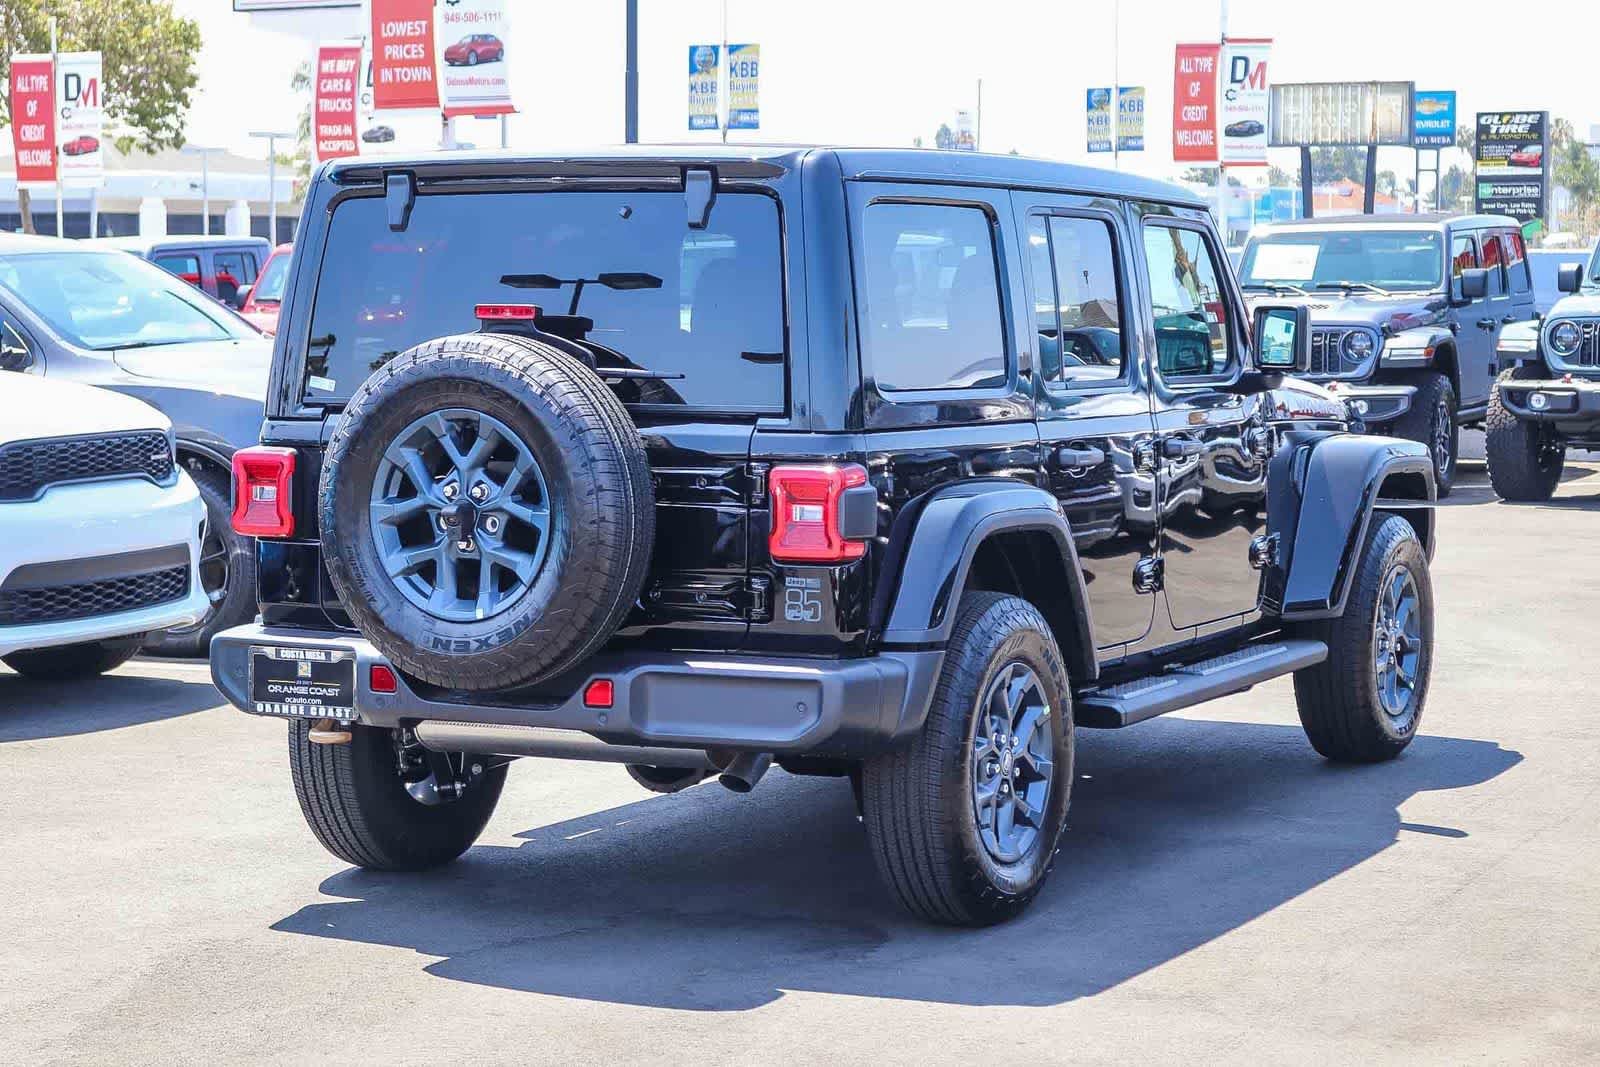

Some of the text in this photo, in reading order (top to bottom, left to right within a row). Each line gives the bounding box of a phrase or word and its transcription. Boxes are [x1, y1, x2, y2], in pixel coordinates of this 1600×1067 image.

[381, 21, 428, 38] LOWEST
[384, 44, 424, 60] PRICES
[321, 59, 356, 73] WE BUY
[730, 61, 758, 78] KBB
[1180, 57, 1214, 73] ALL TYPE
[380, 67, 432, 83] IN TOWN
[15, 75, 49, 92] ALL TYPE
[320, 78, 343, 93] CARS
[1190, 81, 1201, 97] OF
[26, 99, 38, 118] OF
[319, 98, 352, 112] TRUCKS
[1182, 105, 1208, 121] CREDIT
[1480, 113, 1541, 125] GLOBE
[21, 124, 46, 142] CREDIT
[1177, 129, 1214, 145] WELCOME
[1489, 124, 1531, 134] TIRE
[17, 149, 52, 167] WELCOME
[431, 613, 531, 653] NEXEN
[280, 650, 326, 660] COSTA MESA
[267, 684, 341, 697] ORANGE COAST
[285, 697, 322, 705] ocauto.com
[256, 703, 352, 718] ORANGE COAST
